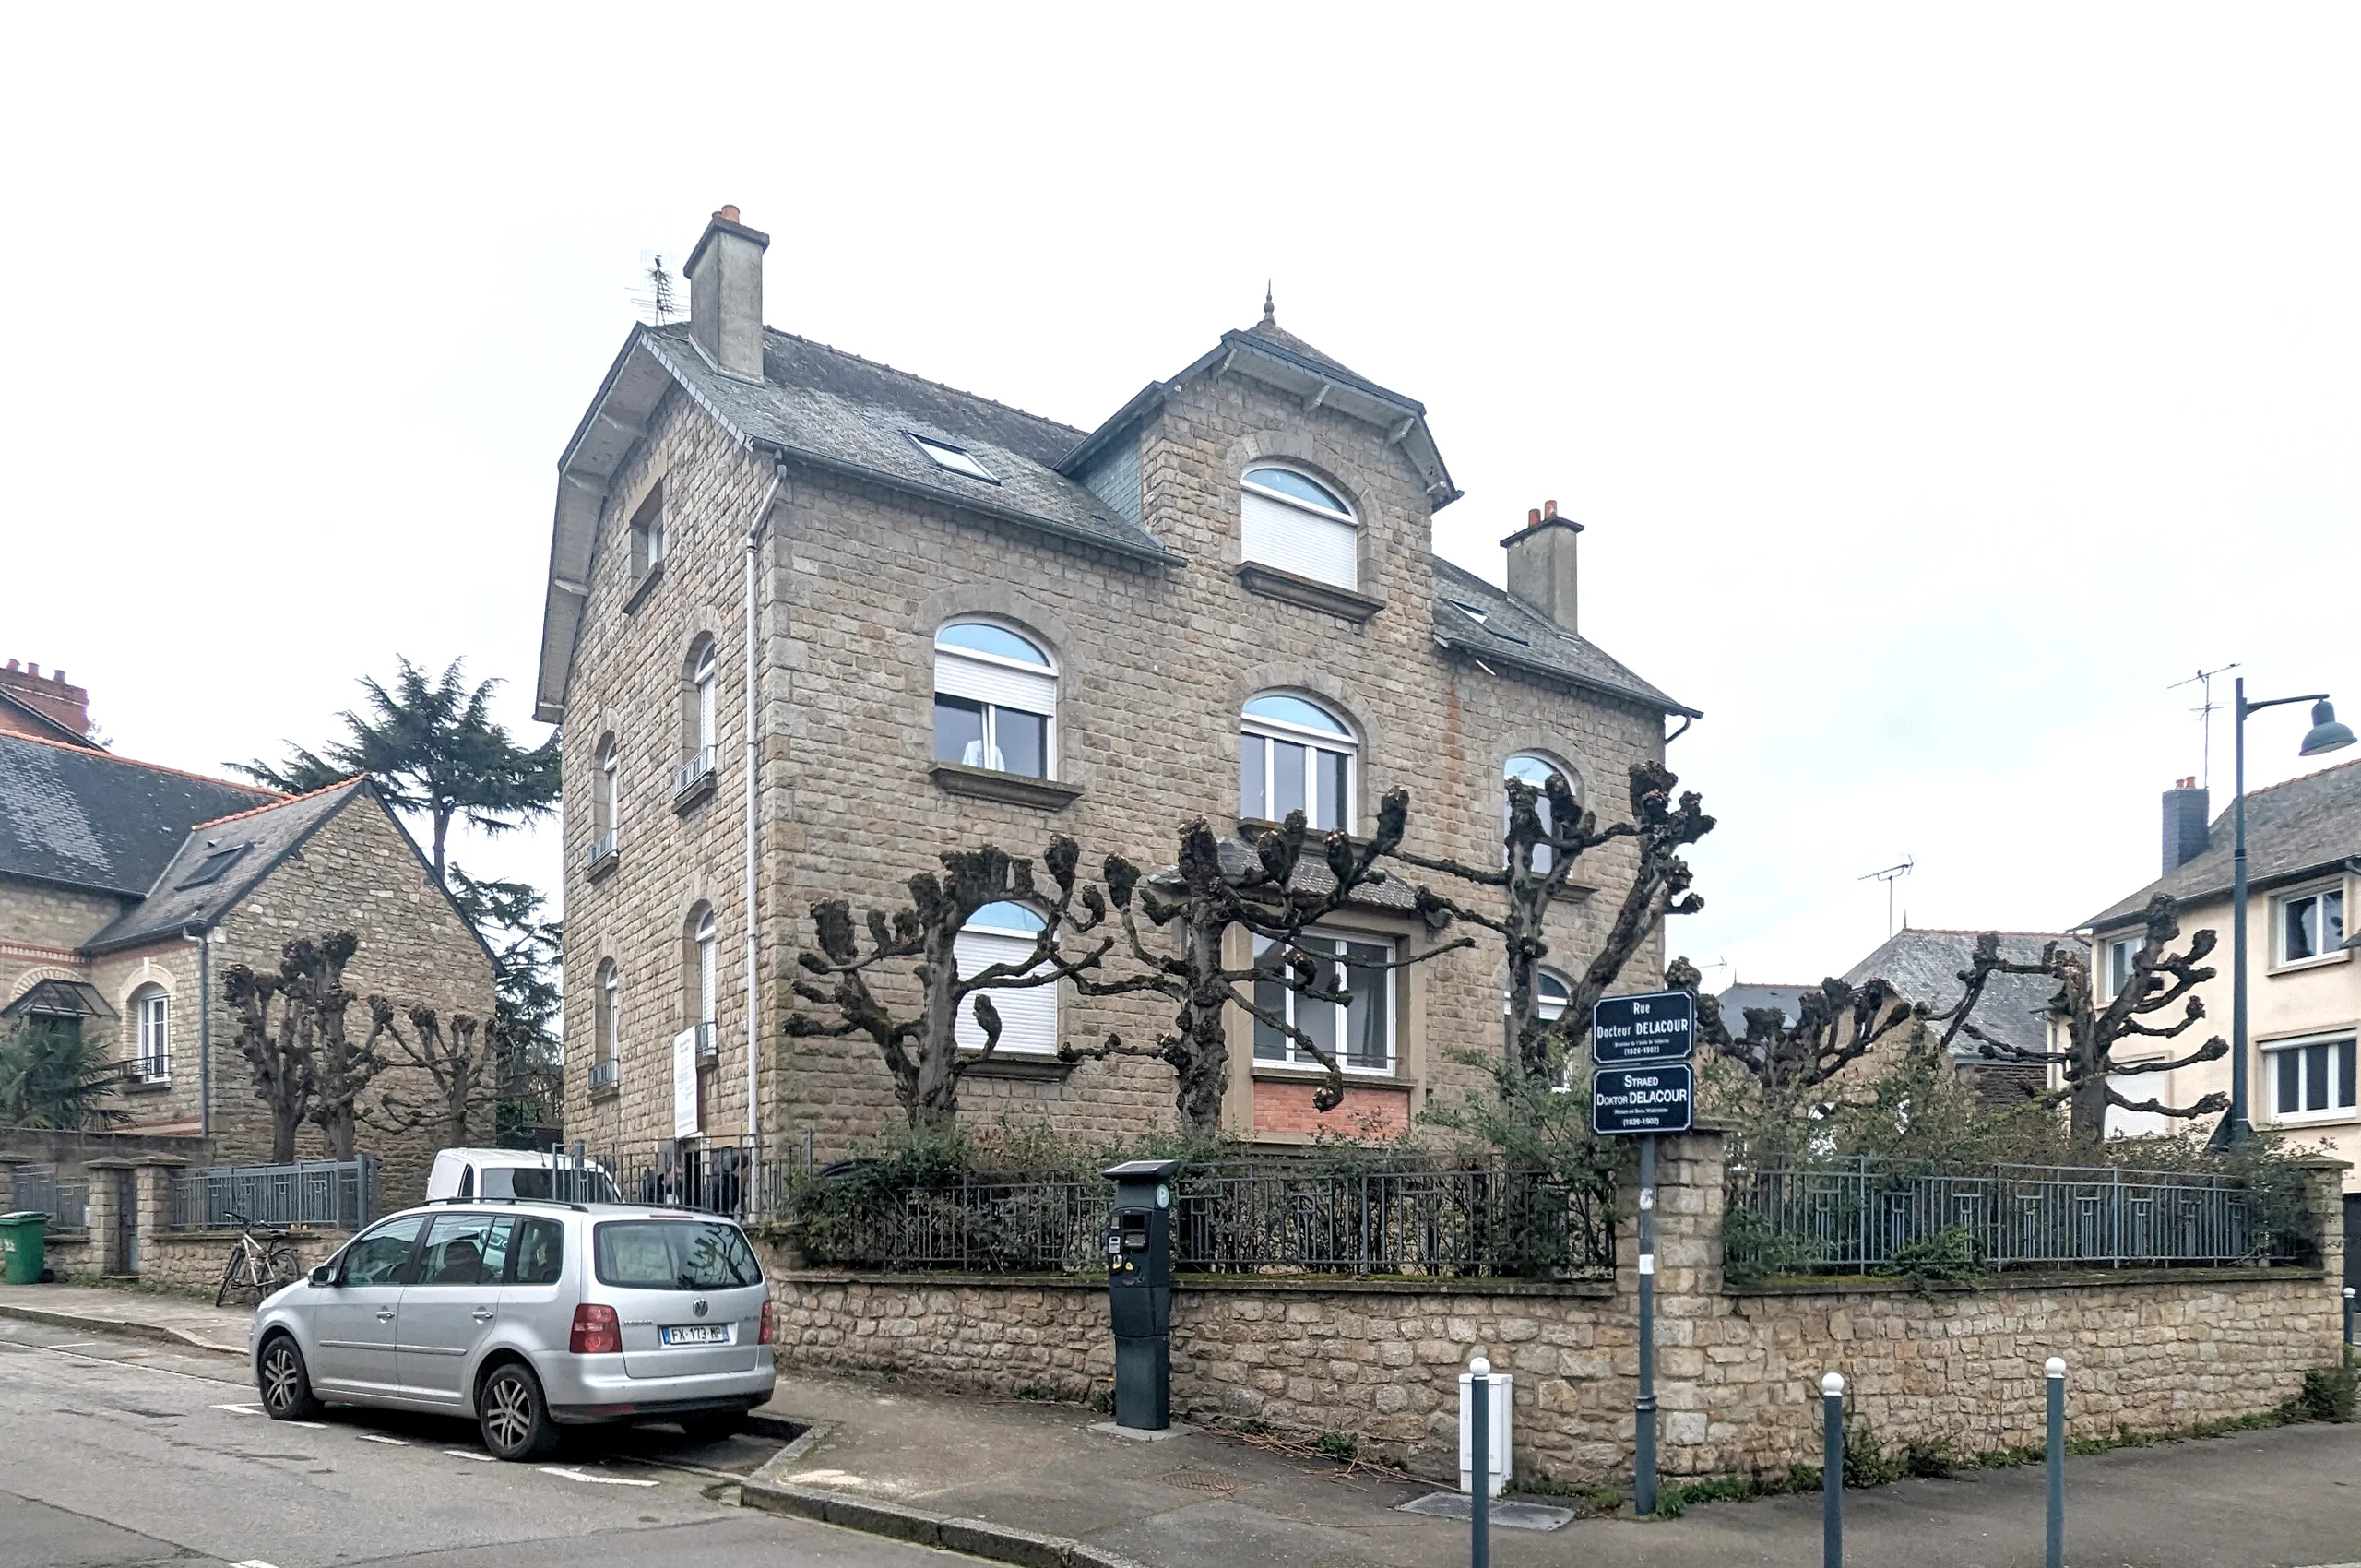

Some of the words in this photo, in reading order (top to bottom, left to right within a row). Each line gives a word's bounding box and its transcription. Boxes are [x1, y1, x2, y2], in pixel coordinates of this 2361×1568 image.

[1633, 1002, 1651, 1015] Rue
[1596, 1025, 1631, 1039] Docteur
[1636, 1019, 1688, 1035] DELACOUR
[1629, 1088, 1688, 1104] DELACOUR
